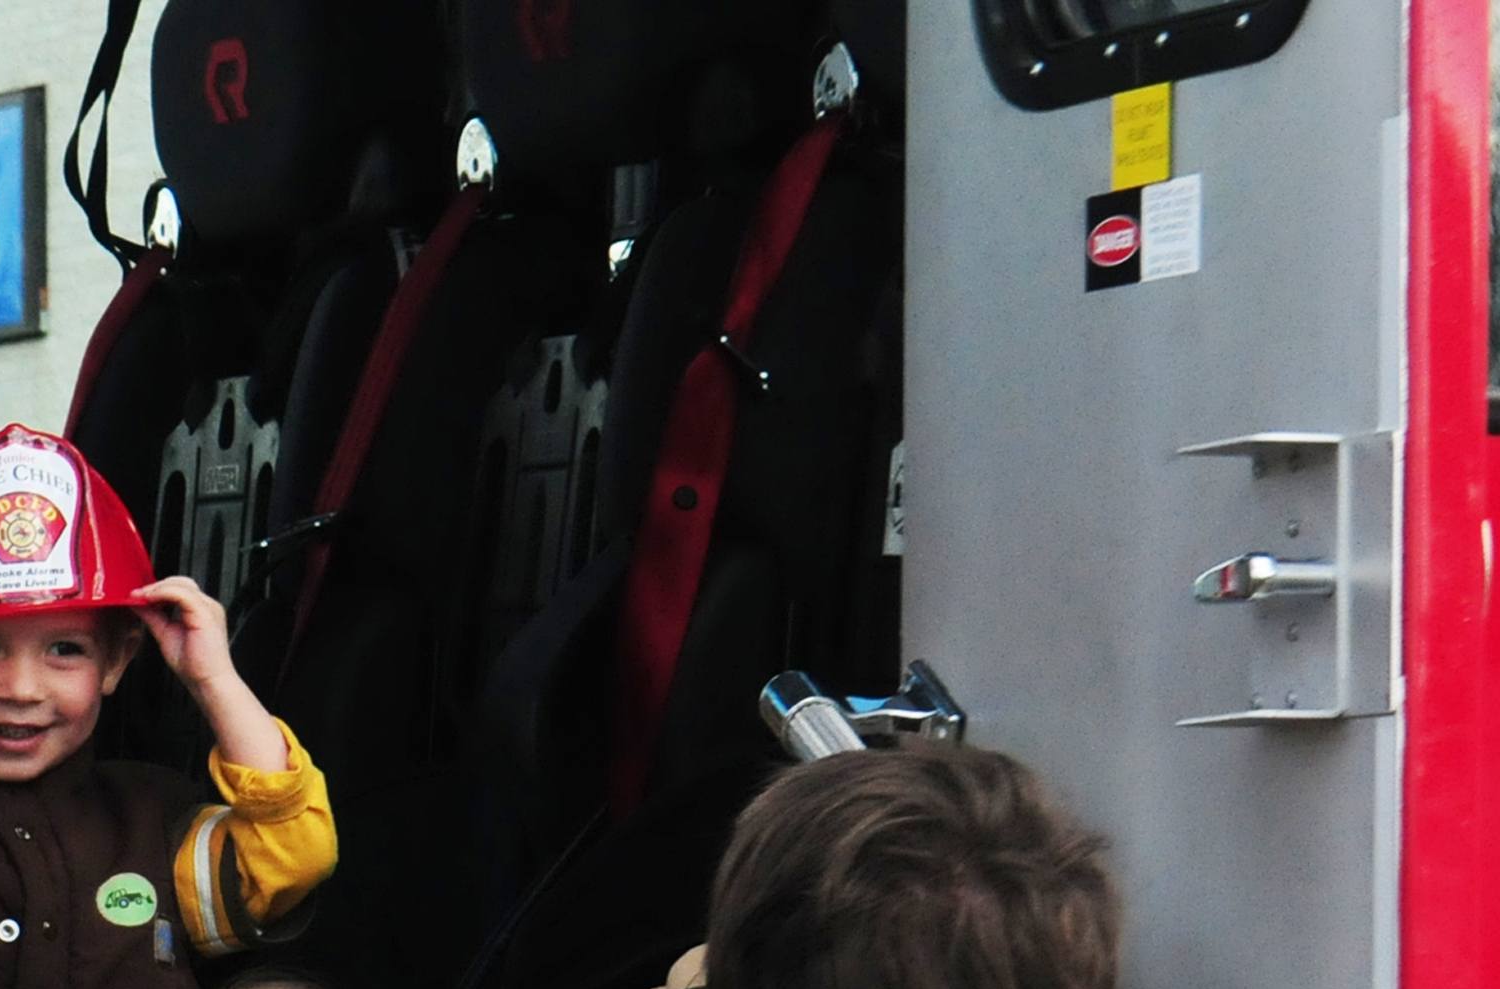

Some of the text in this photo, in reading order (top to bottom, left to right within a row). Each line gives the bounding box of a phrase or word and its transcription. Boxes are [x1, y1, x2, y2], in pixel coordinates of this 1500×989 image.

[204, 36, 250, 125] R
[12, 464, 74, 496] CHIEF
[25, 577, 58, 587] Lives!
[26, 566, 65, 577] Alarms
